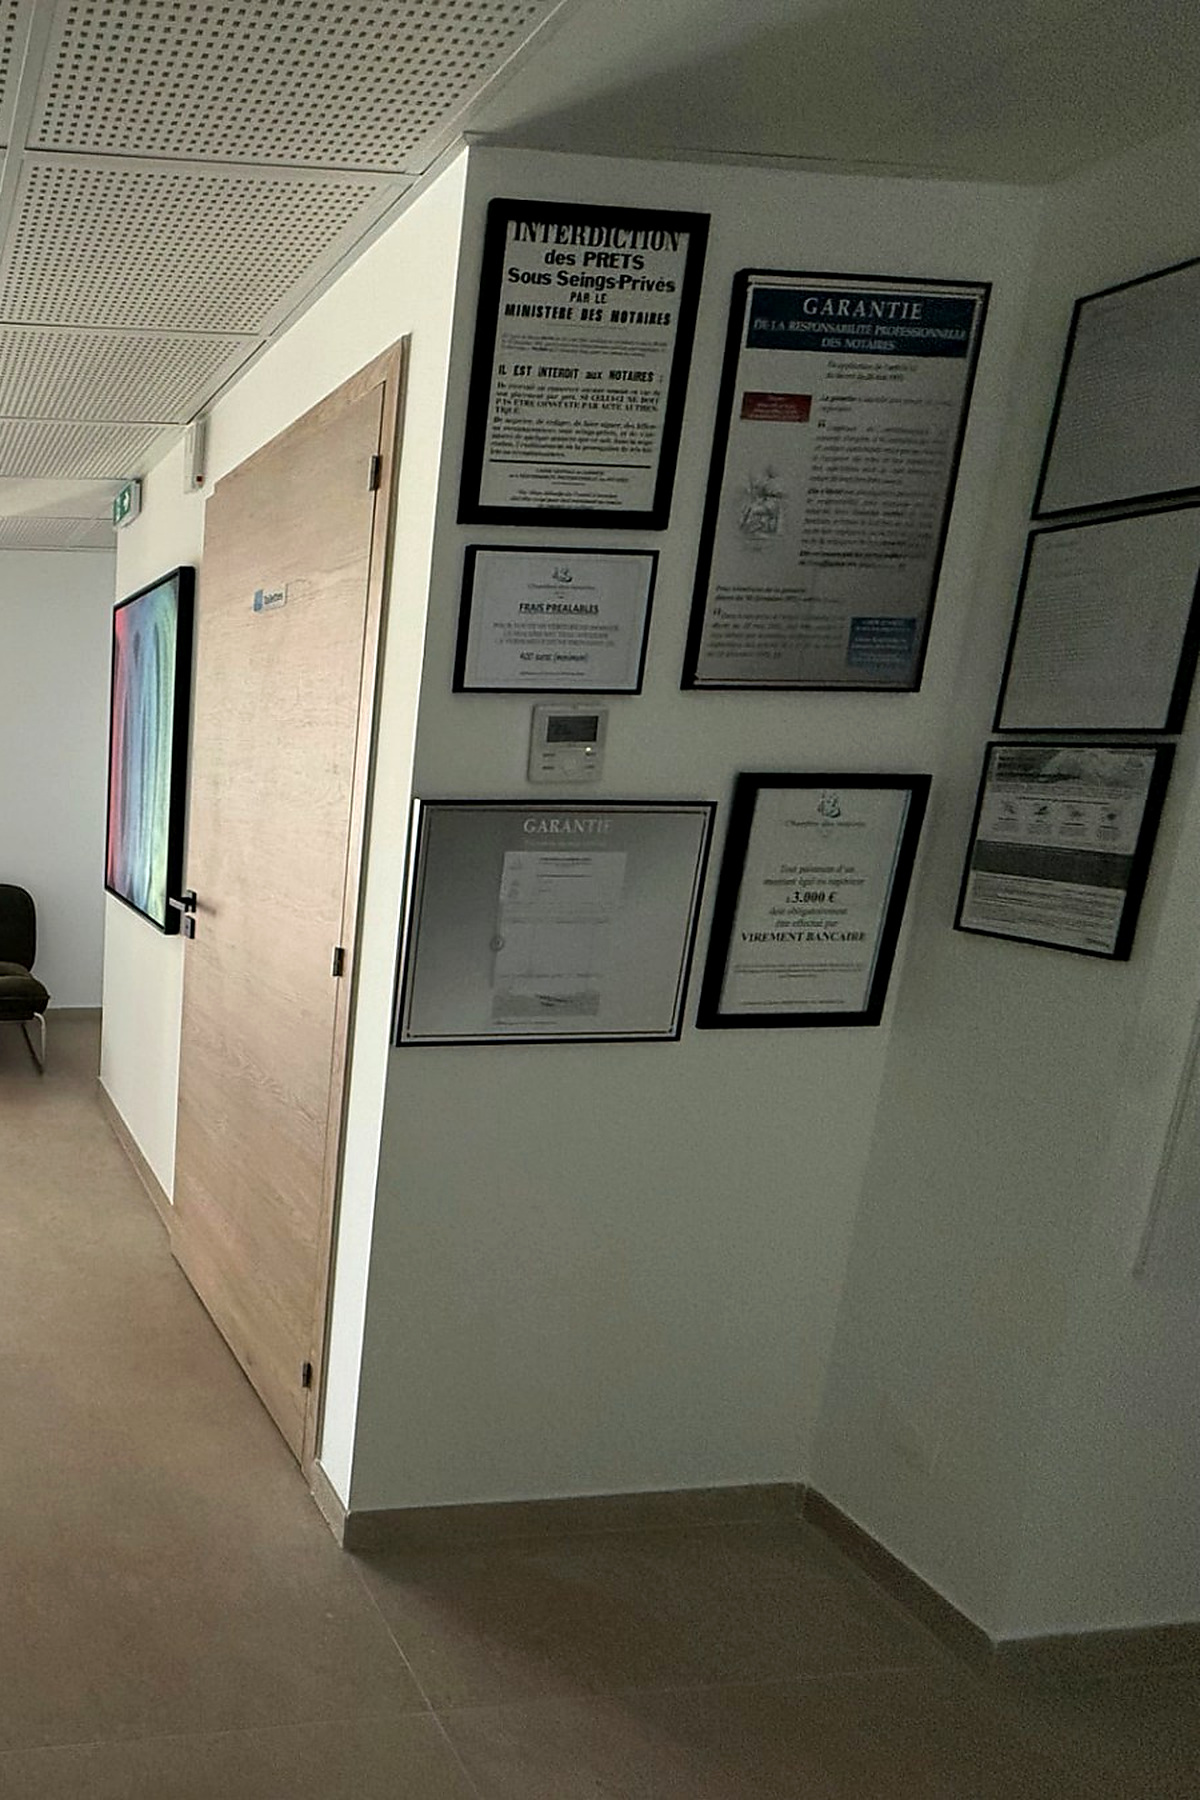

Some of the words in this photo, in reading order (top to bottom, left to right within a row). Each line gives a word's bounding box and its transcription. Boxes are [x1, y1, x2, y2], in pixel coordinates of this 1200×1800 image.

[513, 219, 682, 252] INTERDICTION
[544, 249, 576, 267] des
[582, 250, 646, 271] PRETS
[507, 266, 552, 287] Sous
[569, 291, 591, 304] PAR
[594, 292, 609, 305] LE
[580, 307, 604, 322] DES
[610, 309, 672, 327] NOTAIRES
[803, 297, 924, 320] GARANTIE
[821, 337, 842, 348] DES
[845, 338, 896, 351] NOTAIRES
[498, 363, 508, 376] IL
[513, 364, 533, 378] EST
[537, 365, 580, 380] INTERDIT
[585, 370, 604, 380] aux
[608, 368, 655, 383] NOTAIRES
[523, 818, 614, 834] GARANTIE
[791, 891, 826, 904] 3.000
[828, 891, 839, 904] €
[740, 930, 804, 943] VIREMENT
[805, 930, 867, 943] BANCAIRE
